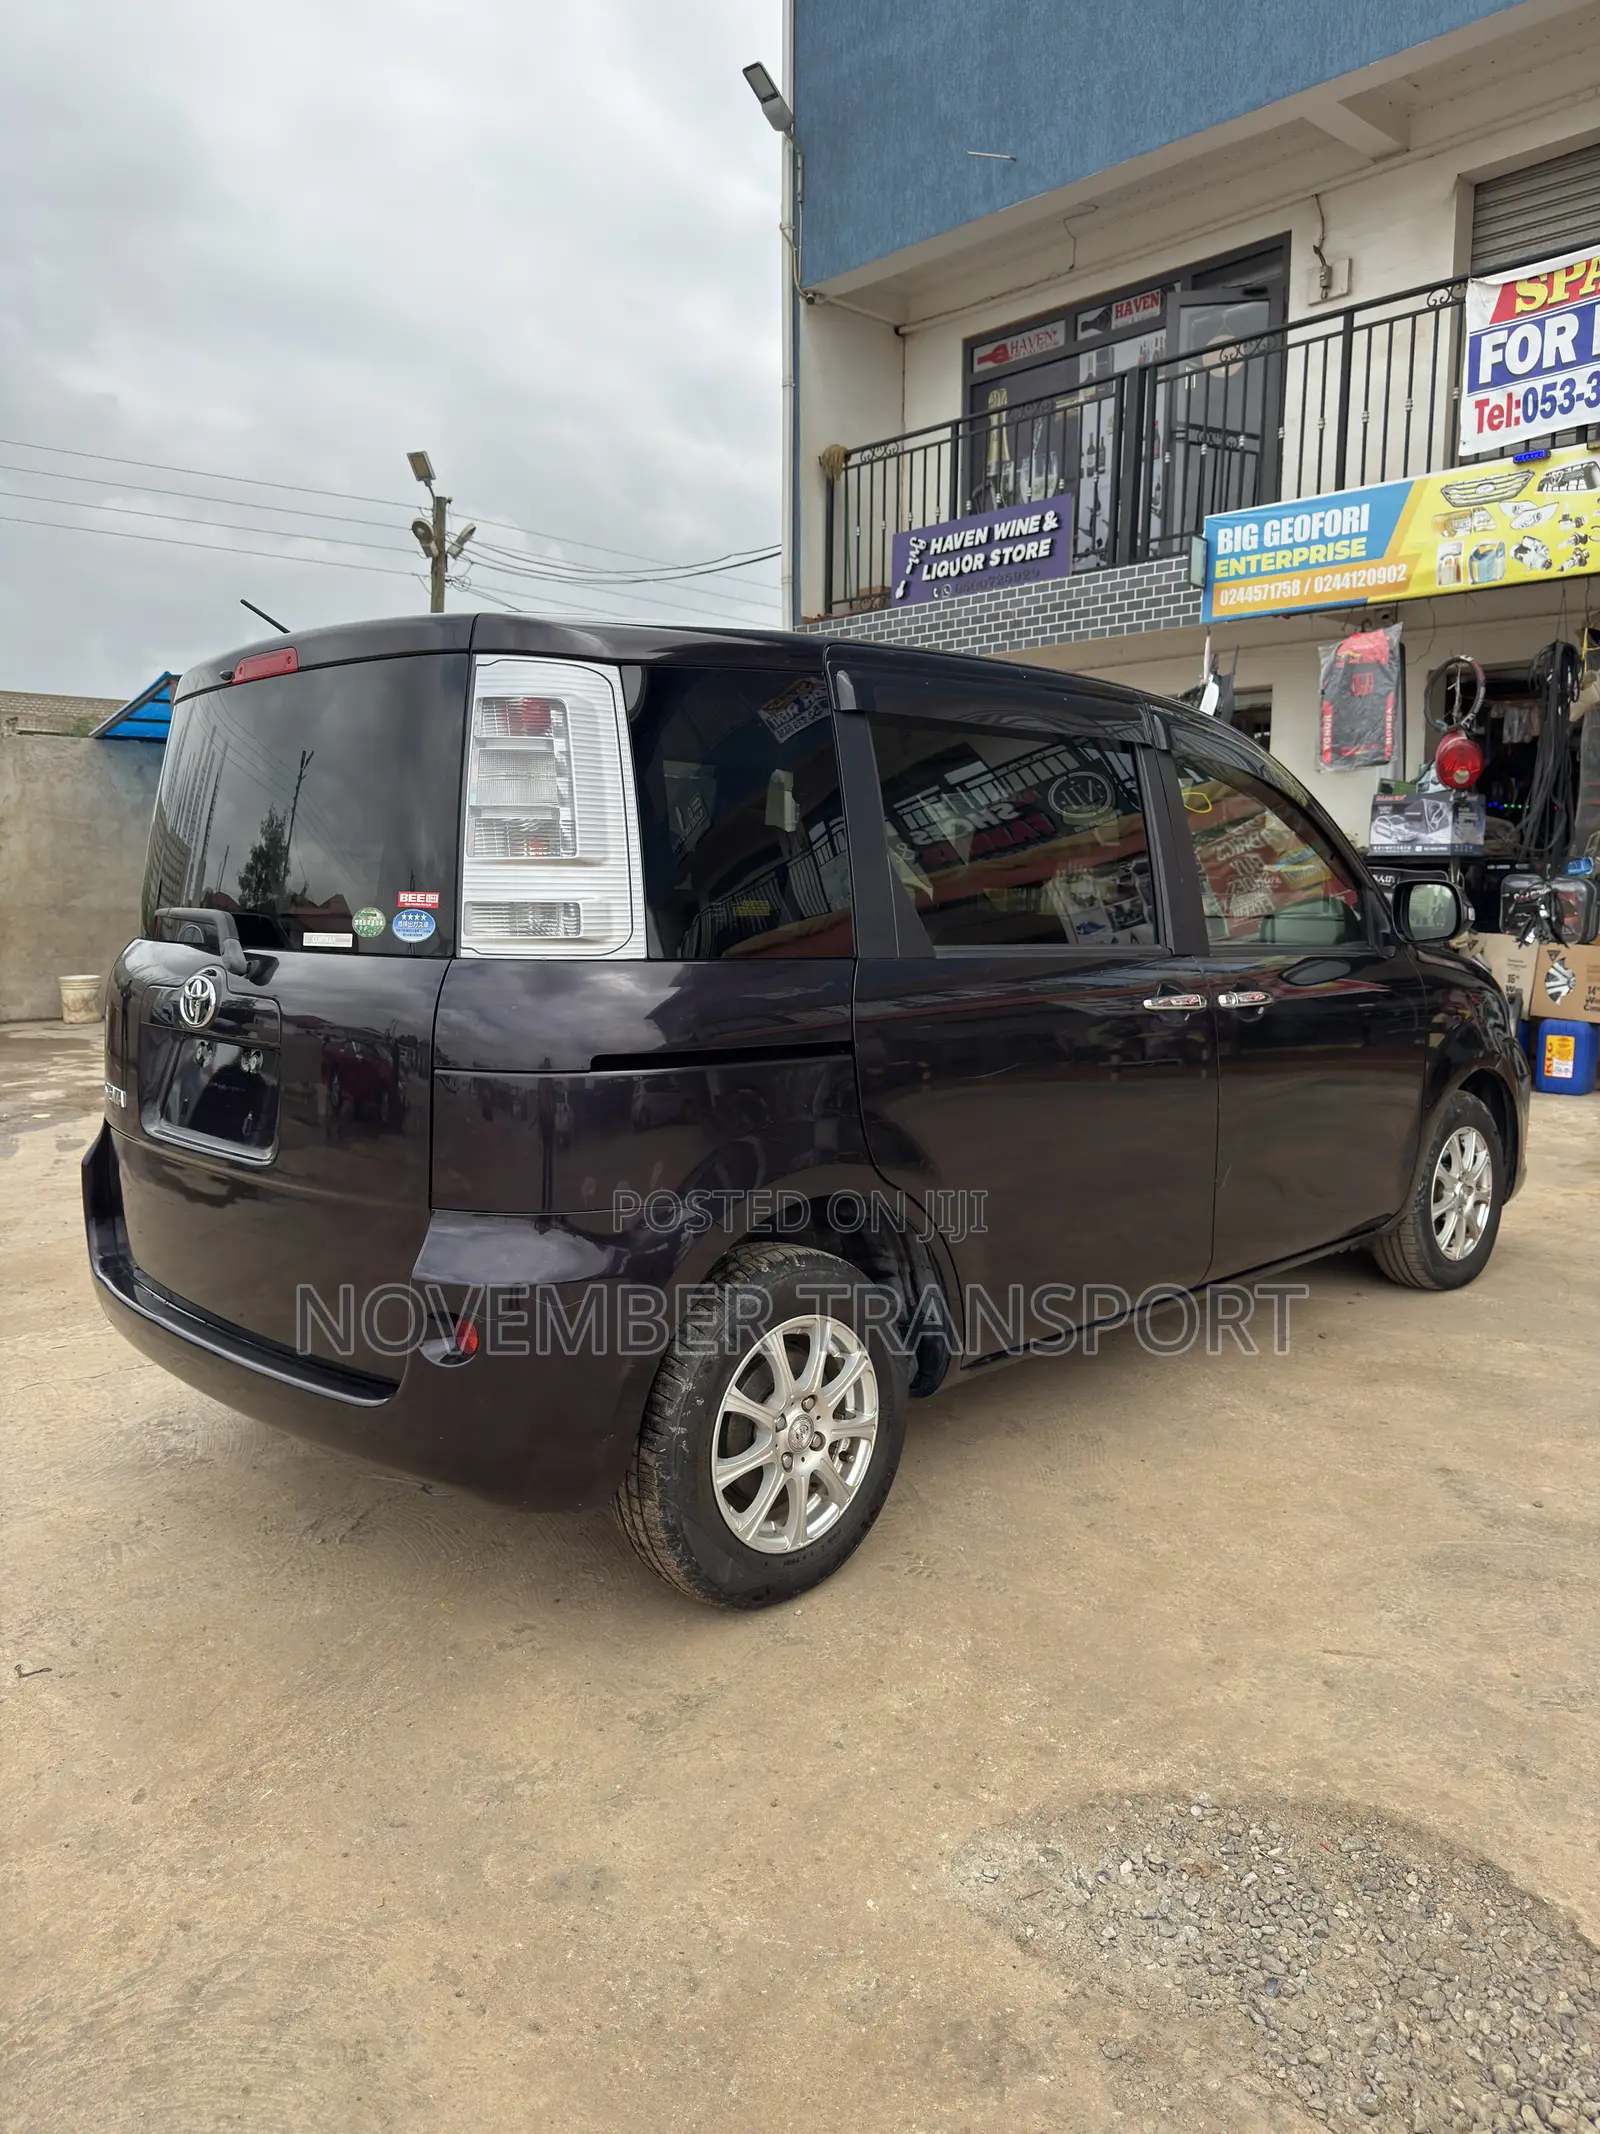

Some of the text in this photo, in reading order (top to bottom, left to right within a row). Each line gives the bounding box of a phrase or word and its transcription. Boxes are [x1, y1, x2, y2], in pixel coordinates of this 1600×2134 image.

[1115, 292, 1160, 319] HAVEN
[1479, 313, 1579, 385] FOR
[929, 510, 1059, 555] HAVEN WINE &
[1217, 503, 1370, 555] BIG GEOFORI
[921, 538, 1052, 581] LIQUOR STORE
[1215, 536, 1367, 578] ENTERPRISE
[1220, 578, 1300, 606] 0244571758
[1314, 563, 1408, 593] 0244120902
[1323, 714, 1332, 751] HONDA
[400, 893, 425, 903] BEE
